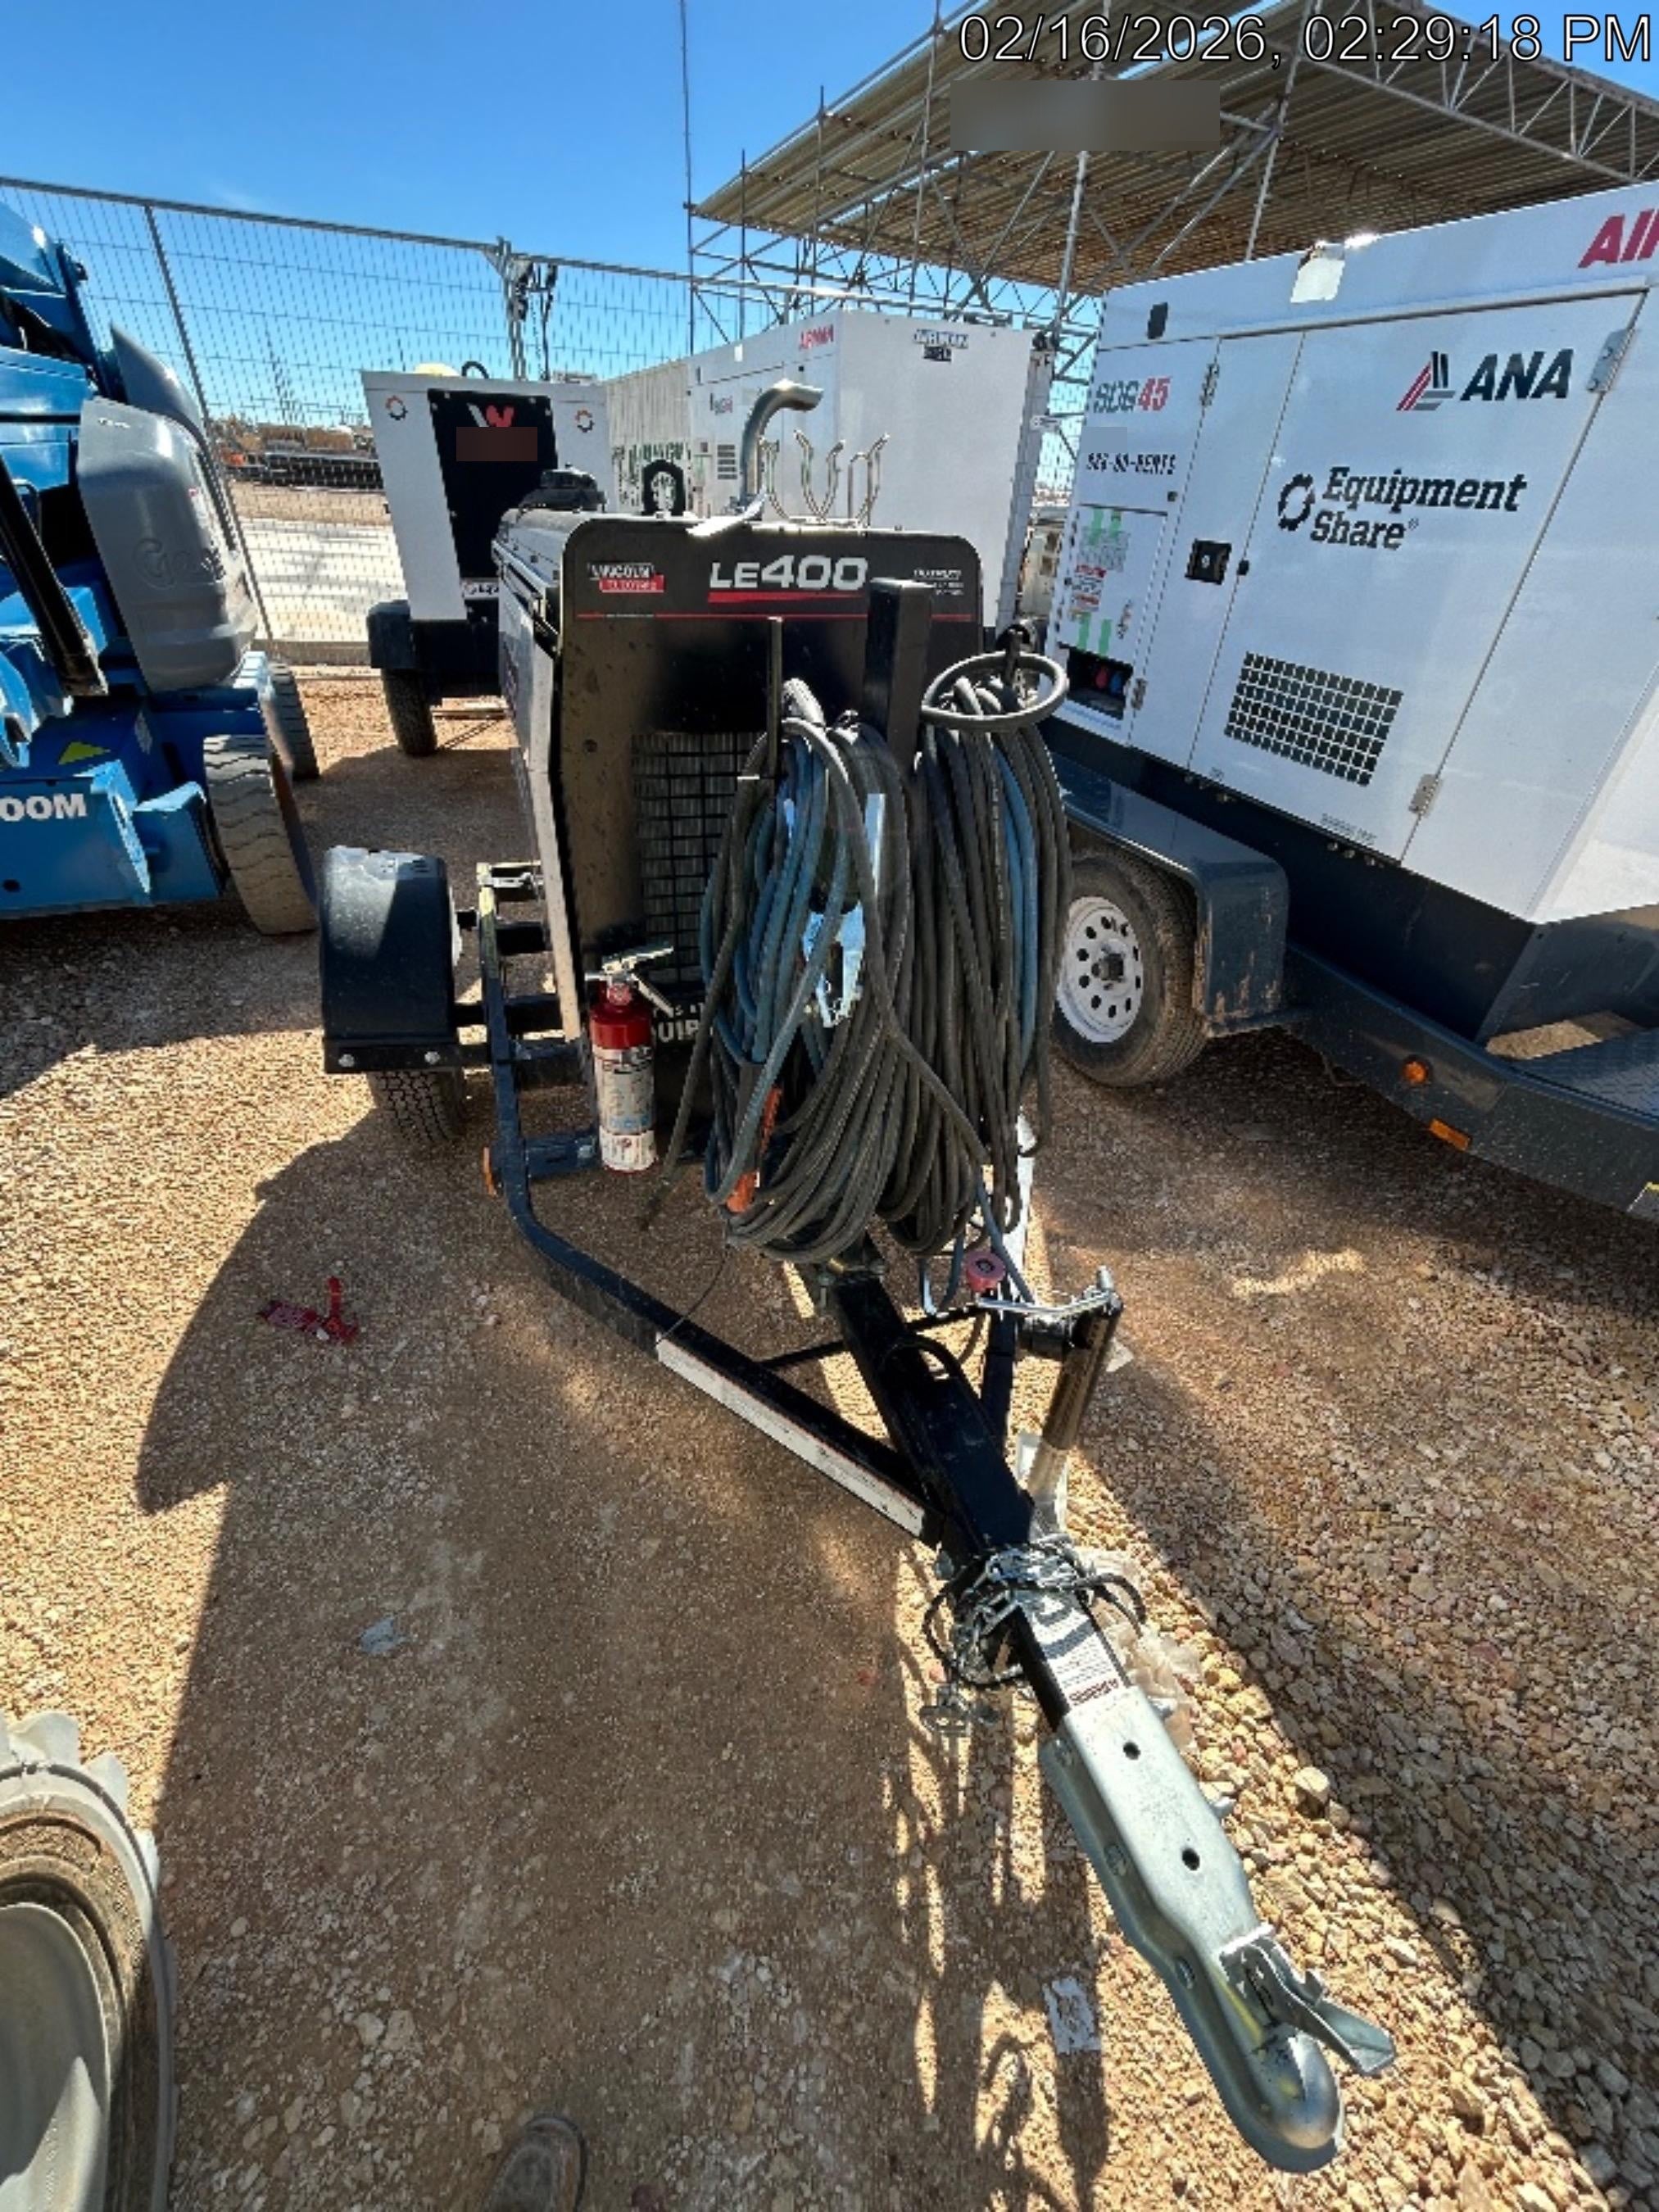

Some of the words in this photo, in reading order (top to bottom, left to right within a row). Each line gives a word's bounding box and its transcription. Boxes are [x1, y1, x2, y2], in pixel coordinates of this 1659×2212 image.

[1460, 348, 1574, 401] ANA
[1321, 466, 1528, 514] Equipment
[709, 555, 869, 591] LE400
